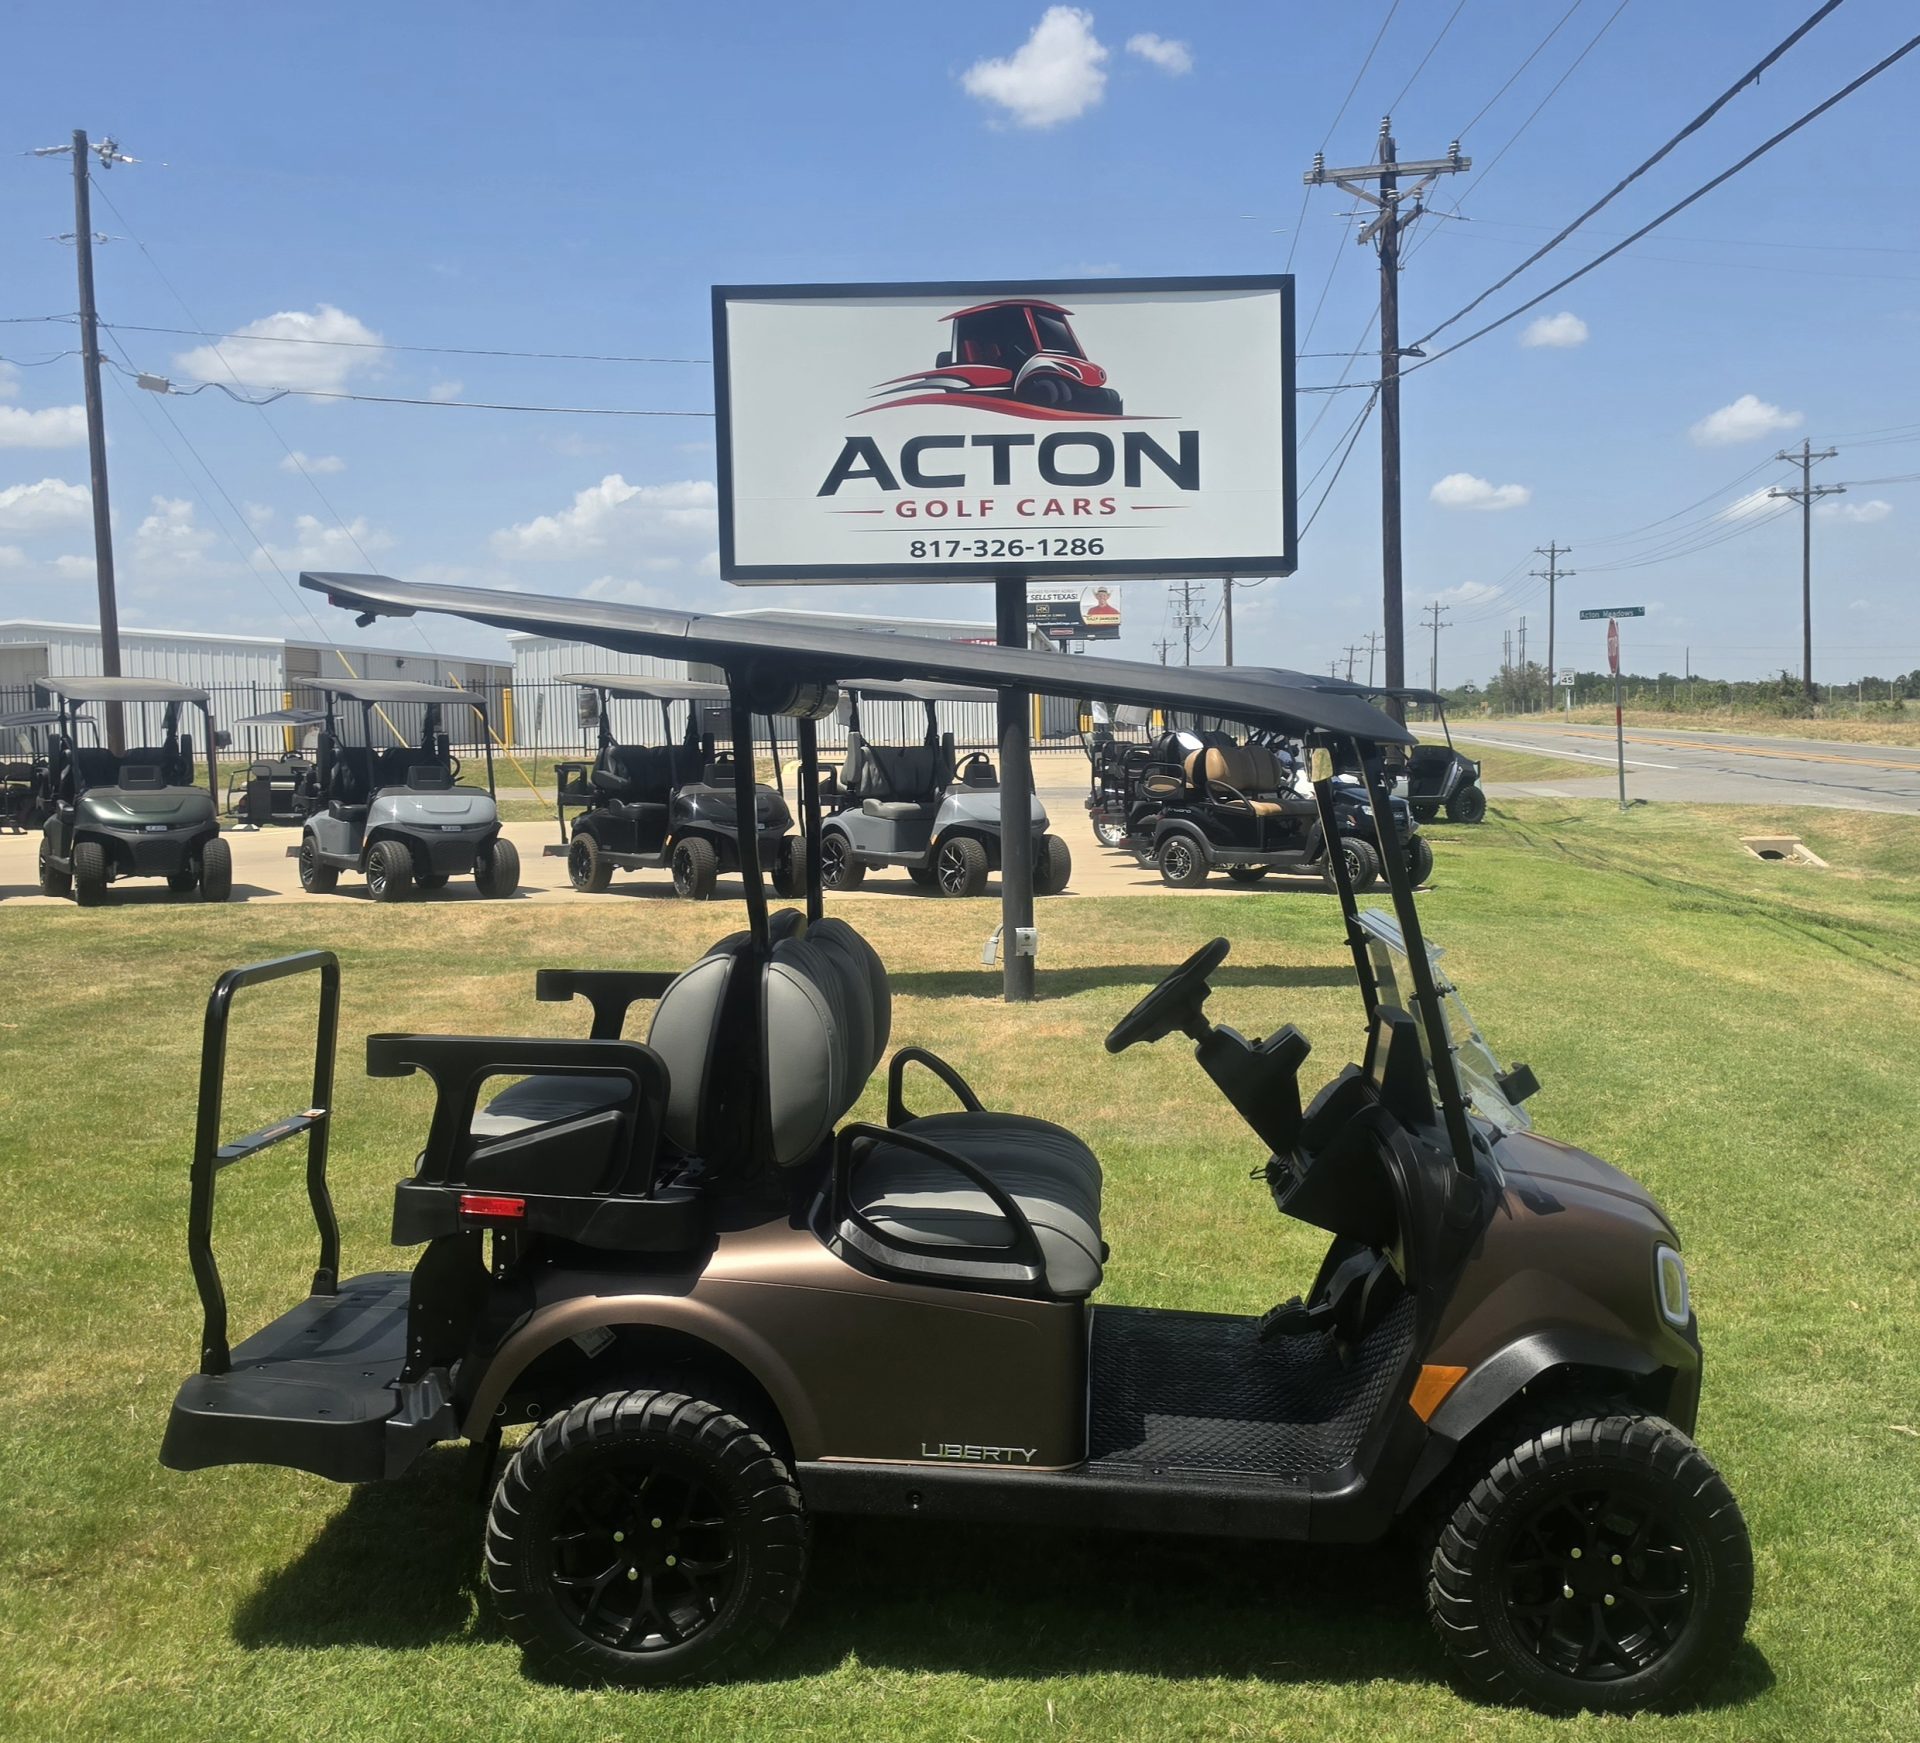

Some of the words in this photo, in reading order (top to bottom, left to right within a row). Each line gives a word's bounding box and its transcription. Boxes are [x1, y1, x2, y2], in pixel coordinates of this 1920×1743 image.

[816, 430, 1200, 497] ACTON
[895, 500, 995, 519] GOLF
[1016, 497, 1117, 518] CARS
[910, 537, 1105, 559] 817-326-1286
[1561, 676, 1574, 684] 45
[921, 1442, 1038, 1463] LIBERTY
